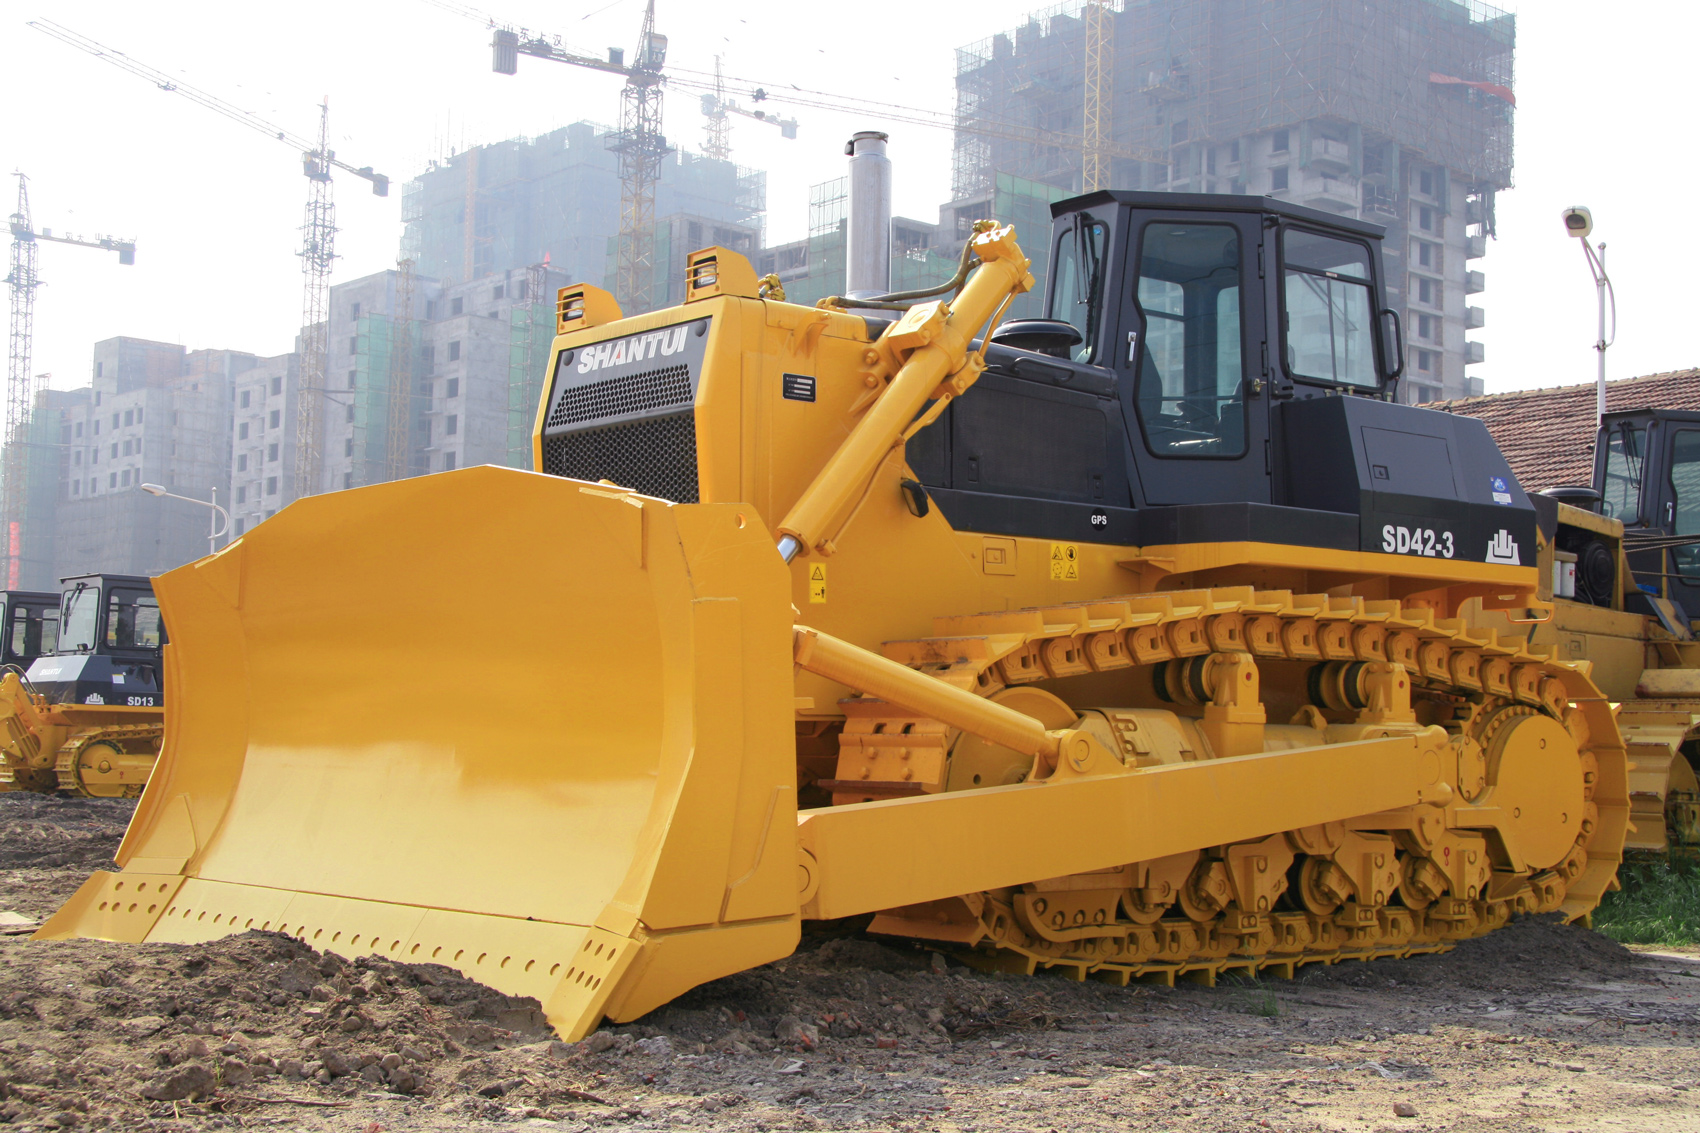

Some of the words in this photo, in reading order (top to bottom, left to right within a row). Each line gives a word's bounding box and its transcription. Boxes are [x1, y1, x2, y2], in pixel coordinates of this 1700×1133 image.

[578, 326, 688, 374] SHANTUI
[1091, 515, 1107, 525] GPS
[1382, 525, 1454, 558] SD42-3
[127, 696, 154, 706] SD13
